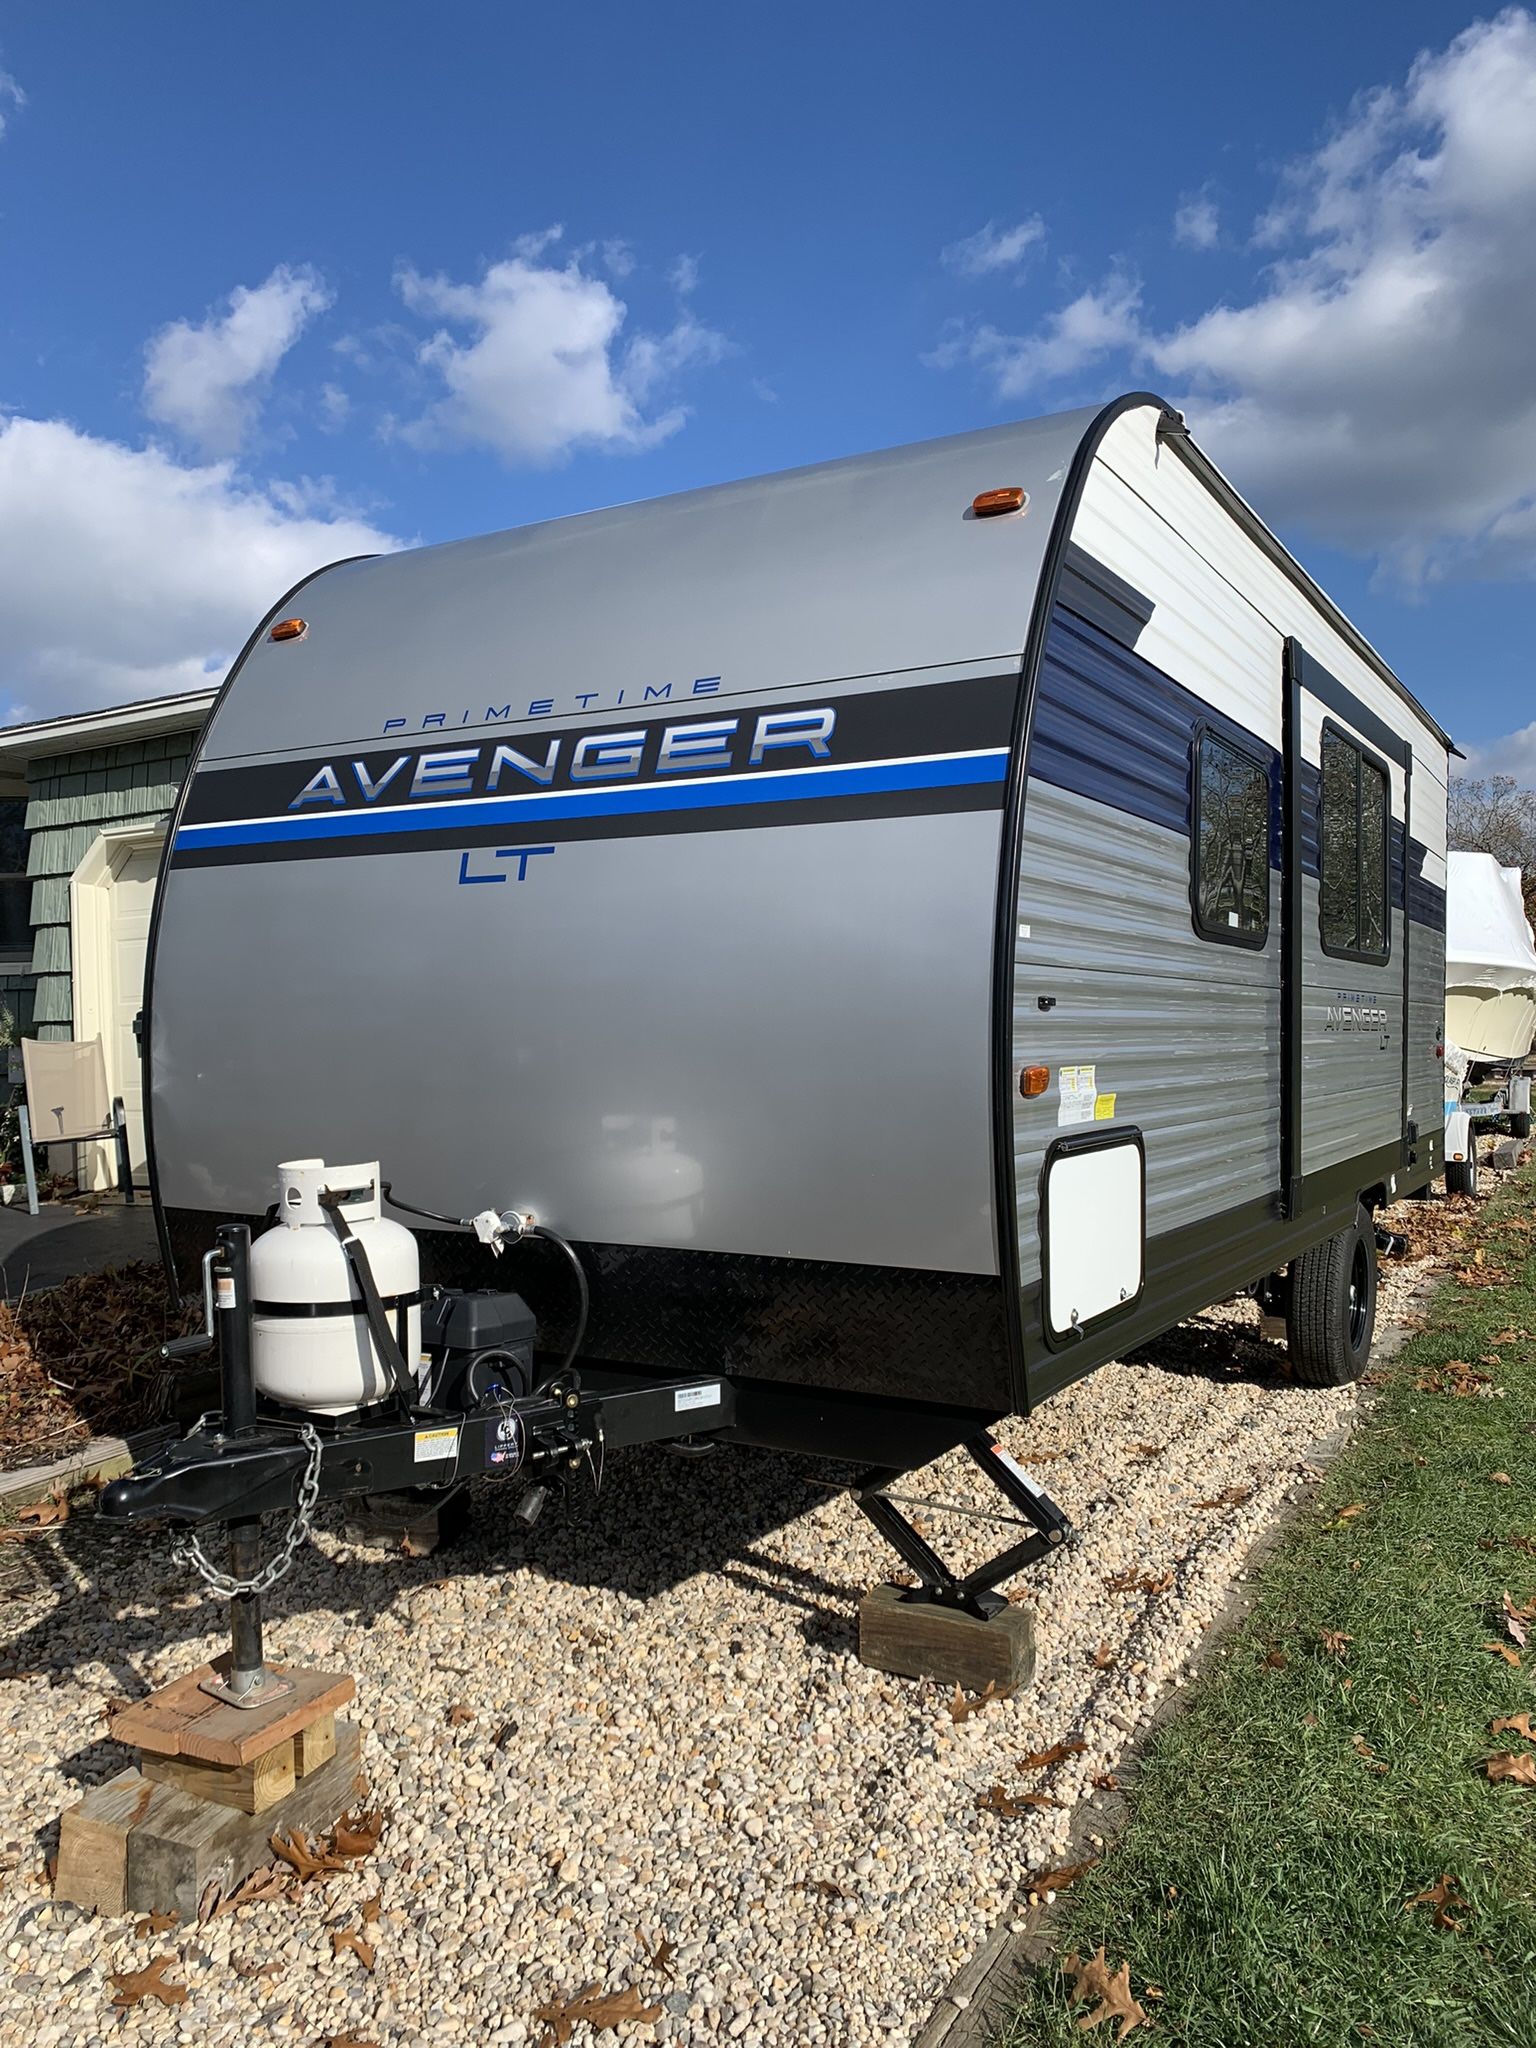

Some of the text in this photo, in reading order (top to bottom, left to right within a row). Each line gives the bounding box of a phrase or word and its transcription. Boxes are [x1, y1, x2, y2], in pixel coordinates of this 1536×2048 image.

[383, 676, 722, 733] PRIMETIME
[287, 707, 839, 809] AVENGER
[458, 846, 556, 885] LT
[1337, 992, 1377, 1004] PRIMETIME
[1324, 1005, 1388, 1032] AVENGER
[1380, 1035, 1390, 1050] LT
[428, 1431, 450, 1439] CAUTION
